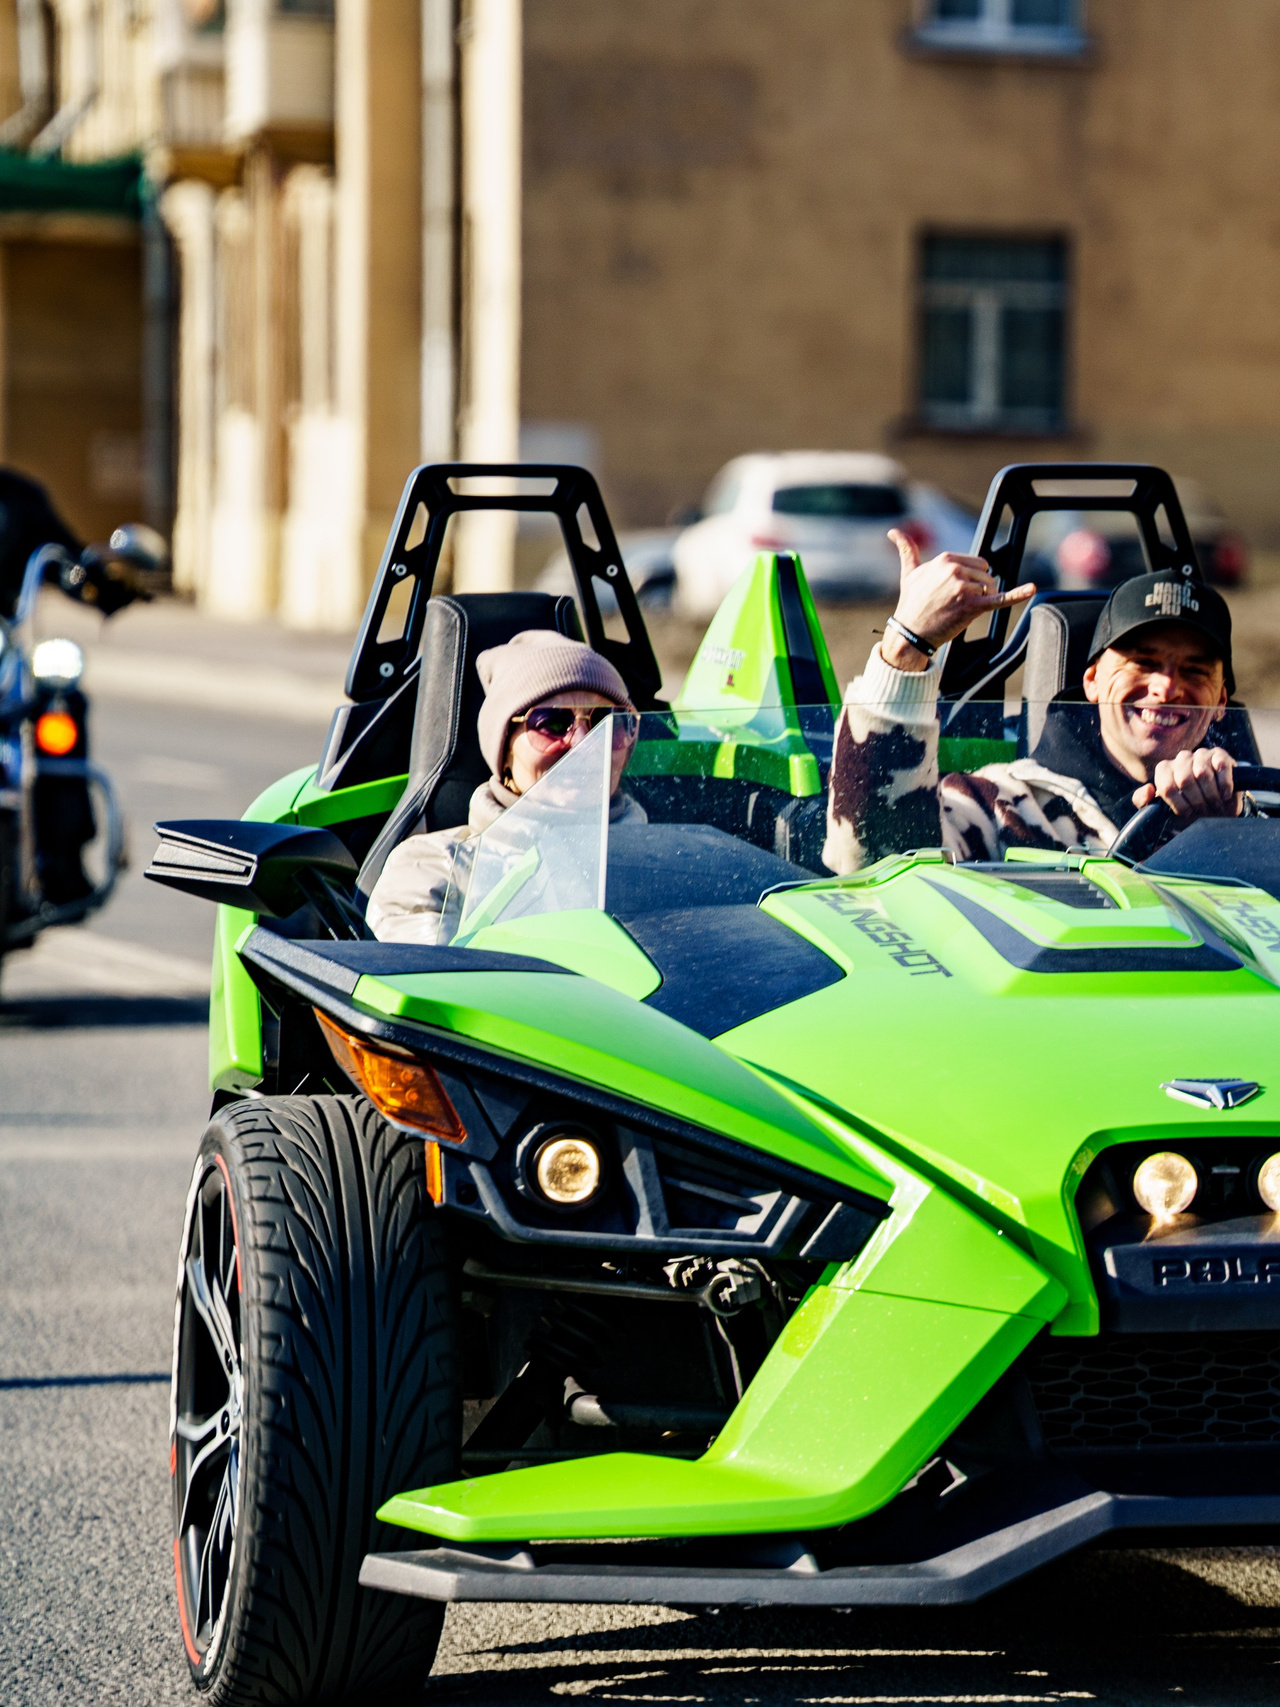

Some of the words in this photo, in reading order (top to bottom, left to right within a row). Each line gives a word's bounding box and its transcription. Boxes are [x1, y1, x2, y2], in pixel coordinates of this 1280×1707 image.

[1153, 582, 1192, 597] HARD
[1145, 592, 1199, 612] ENDURO
[814, 893, 953, 977] SLINGSHOT
